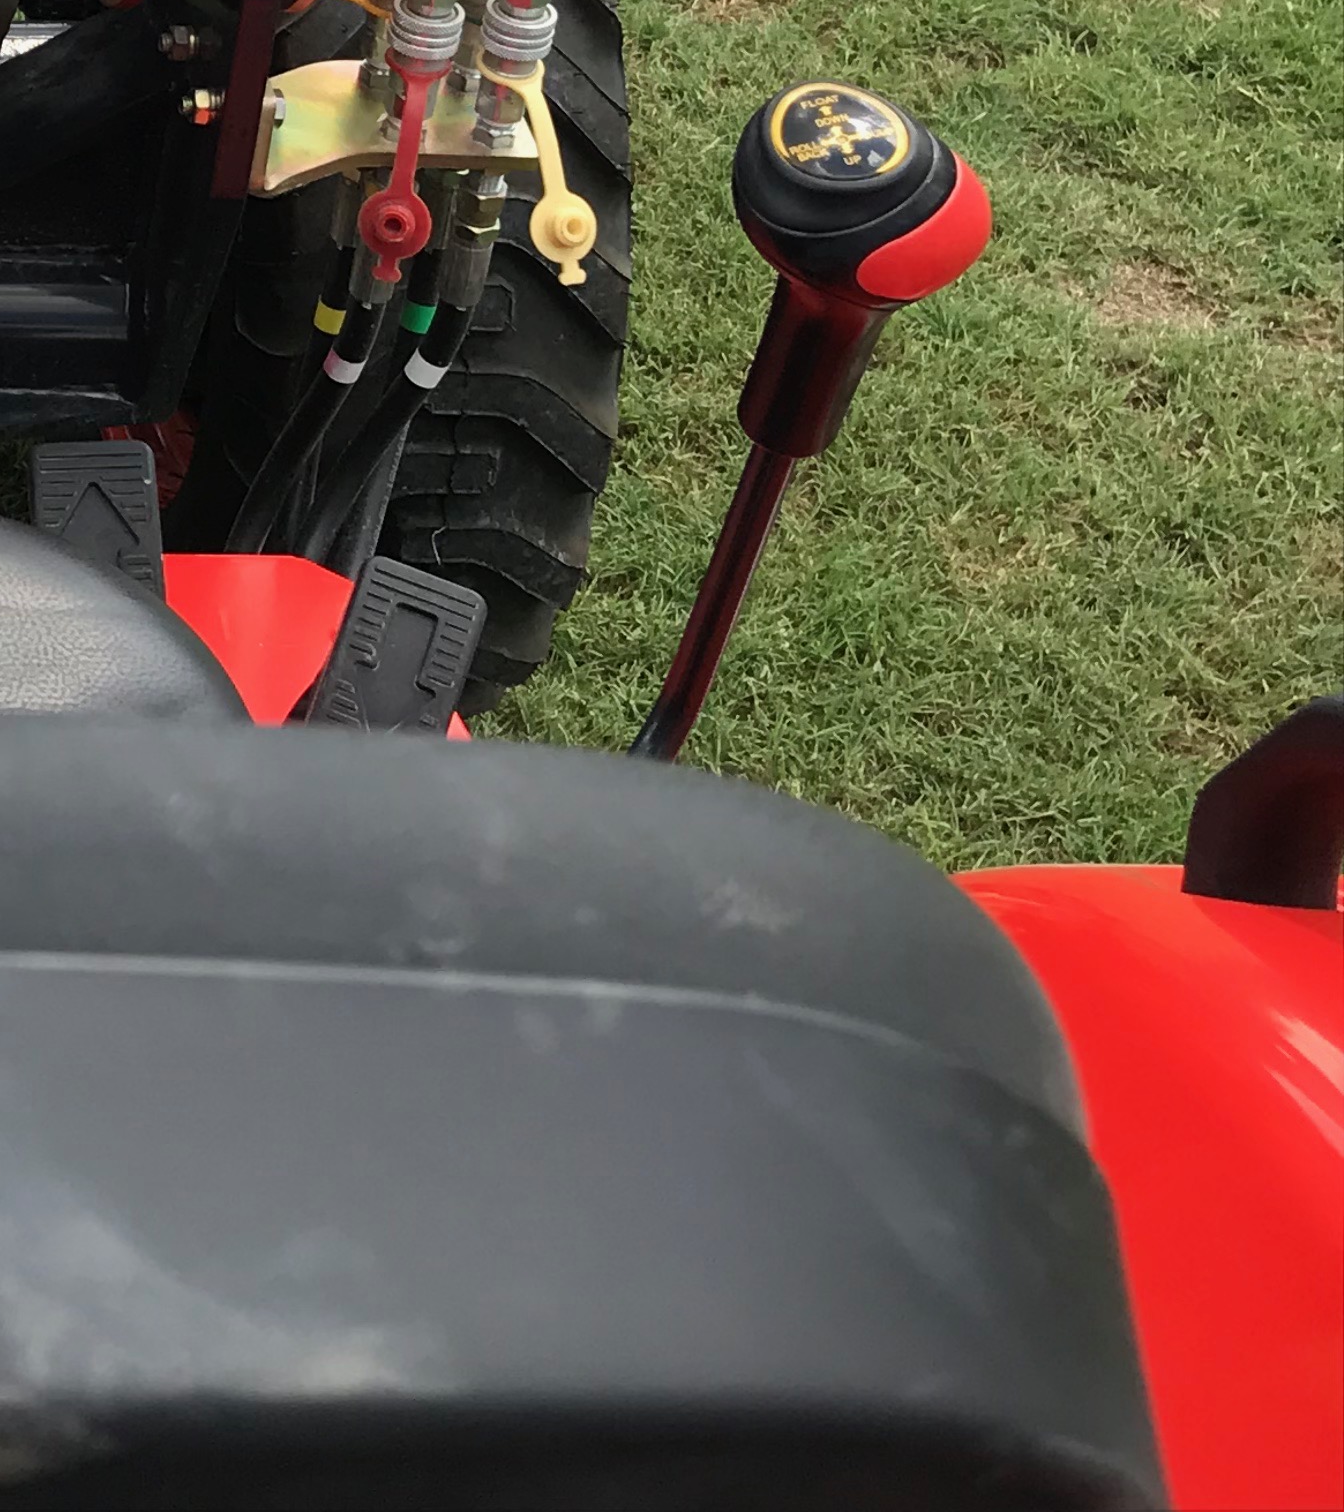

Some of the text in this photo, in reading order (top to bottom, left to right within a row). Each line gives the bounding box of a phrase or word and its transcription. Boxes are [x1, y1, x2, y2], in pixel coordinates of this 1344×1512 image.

[799, 94, 840, 110] FLOAT
[814, 113, 850, 128] DOWN
[843, 154, 862, 166] UP
